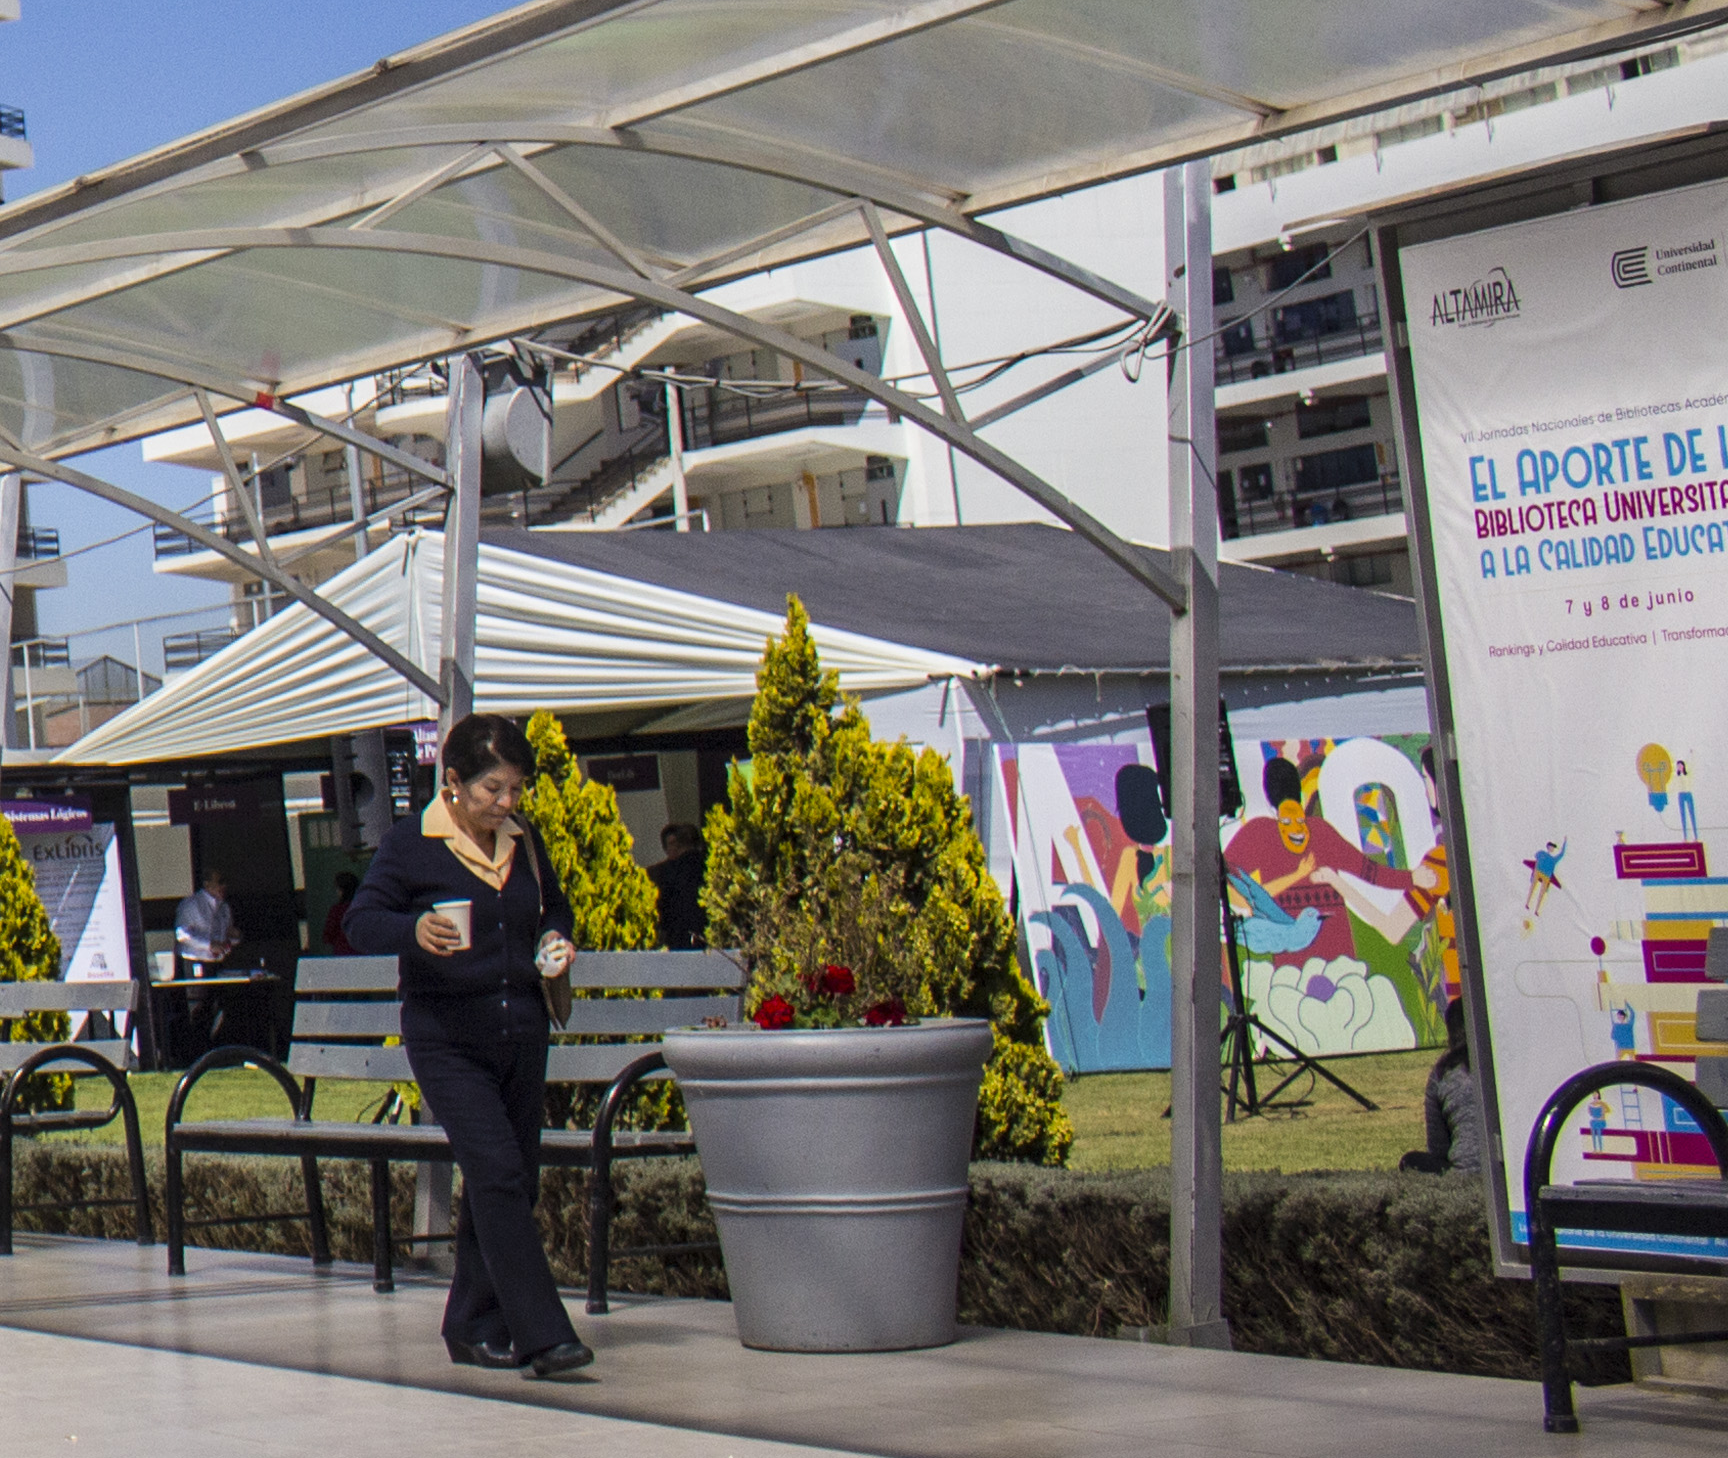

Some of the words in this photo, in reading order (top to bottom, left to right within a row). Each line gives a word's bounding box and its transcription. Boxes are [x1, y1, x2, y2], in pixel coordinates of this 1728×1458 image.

[1655, 239, 1715, 260] Universidad
[1656, 255, 1717, 276] Continental
[1431, 280, 1521, 327] ALTAMIRA
[1461, 429, 1475, 443] VII
[1478, 424, 1530, 441] Jornadas
[1531, 413, 1595, 433] Nacionales
[1598, 410, 1613, 423] de
[1615, 401, 1682, 420] Bibliotecas
[1468, 454, 1506, 503] EL
[1516, 435, 1654, 497] APORTE
[1662, 427, 1708, 477] DE
[1473, 496, 1598, 539] BIBLIOTECA
[1480, 548, 1496, 579] A
[1502, 544, 1531, 577] LA
[1537, 532, 1636, 571] CALIDAD
[1564, 598, 1574, 614] 7
[1583, 600, 1592, 617] y
[1601, 595, 1610, 611] 8
[1619, 593, 1640, 609] de
[1646, 587, 1695, 611] junio
[1488, 642, 1535, 658] Rankings
[1538, 643, 1544, 656] y
[1546, 638, 1591, 653] Calidad
[1592, 633, 1648, 649] Educativa
[50, 806, 88, 822] Lógicos
[33, 842, 104, 861] ExLibris
